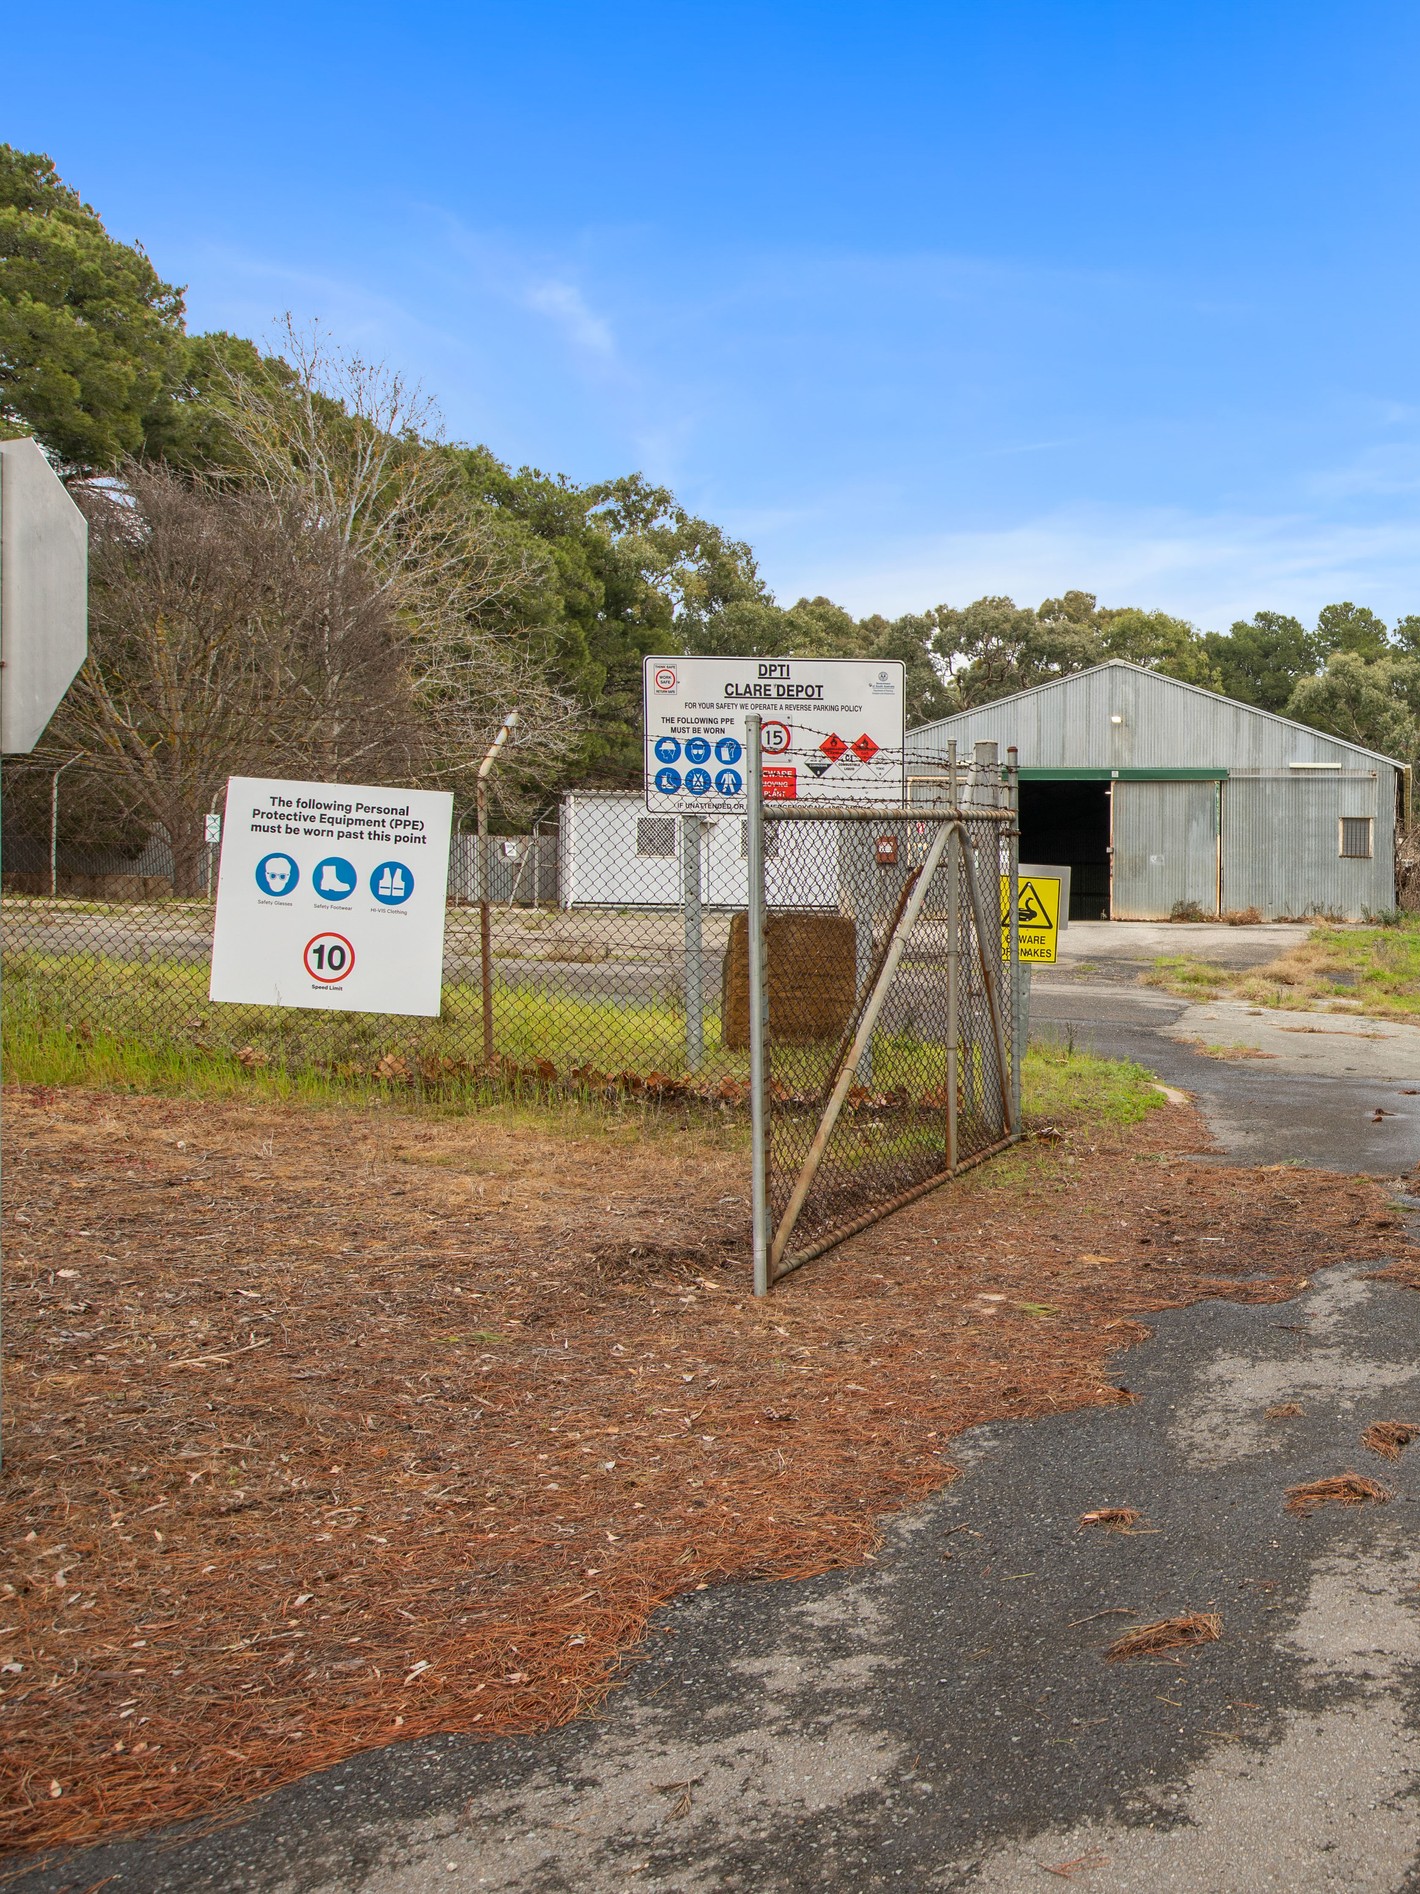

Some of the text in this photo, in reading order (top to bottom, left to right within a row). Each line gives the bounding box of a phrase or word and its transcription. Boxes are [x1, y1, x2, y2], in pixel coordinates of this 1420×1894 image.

[758, 664, 790, 677] DPTI
[724, 683, 824, 698] CLARE DEPOT
[716, 702, 738, 710] SAFETY
[813, 704, 839, 712] PARKING
[766, 730, 783, 745] 15
[269, 796, 410, 816] The following Personal
[685, 802, 732, 810] UNATTENDED
[252, 808, 425, 832] Protective Equipment (PPE)
[250, 823, 427, 845] must be worn past this point
[386, 908, 408, 916] Clothing
[312, 944, 346, 971] 10
